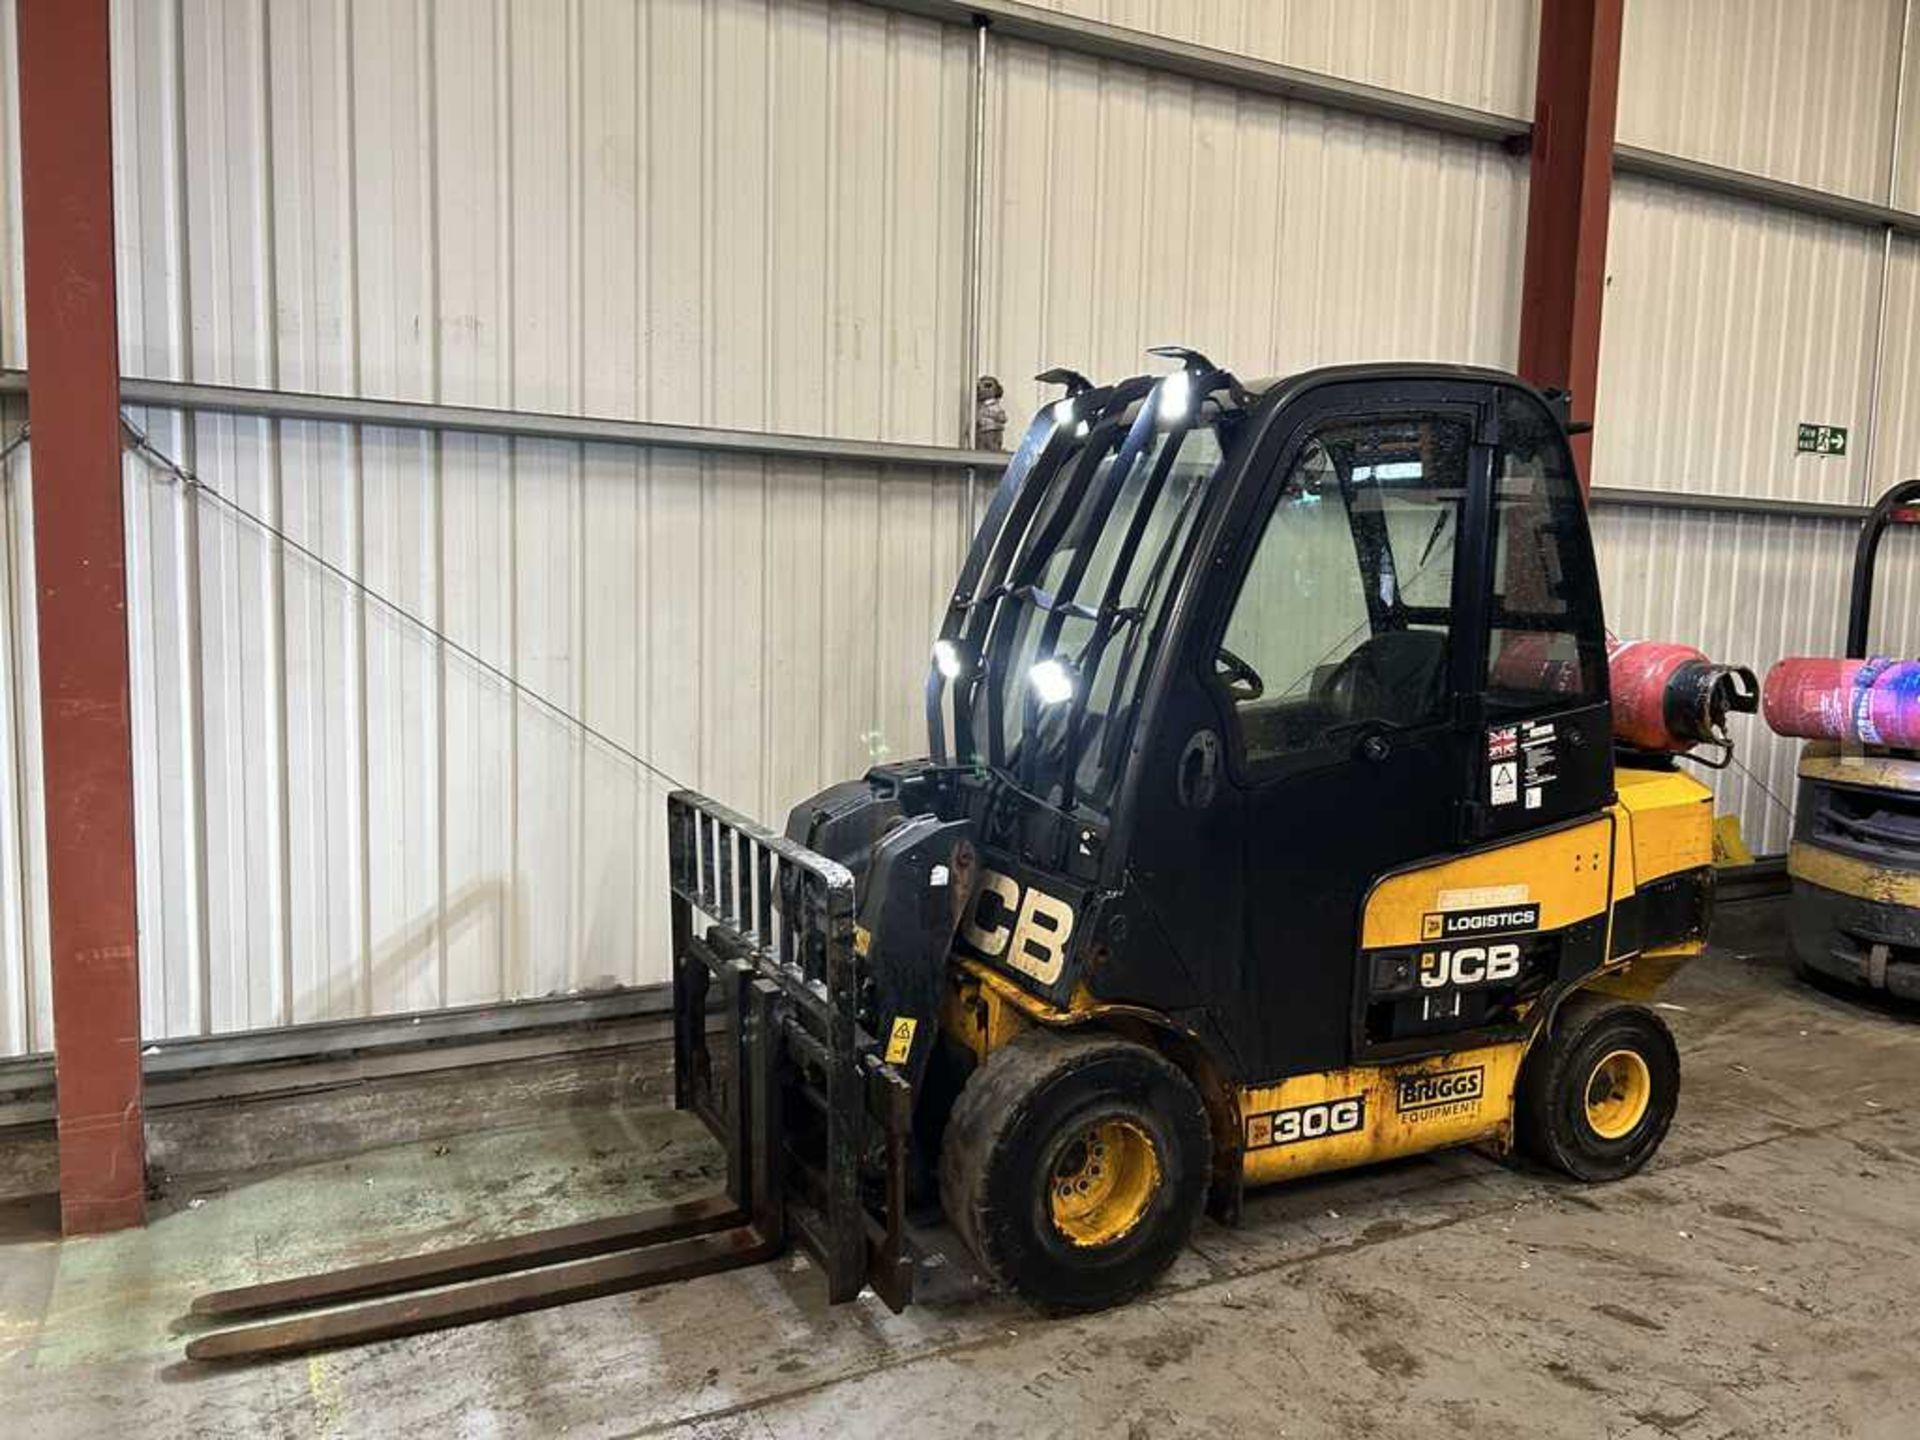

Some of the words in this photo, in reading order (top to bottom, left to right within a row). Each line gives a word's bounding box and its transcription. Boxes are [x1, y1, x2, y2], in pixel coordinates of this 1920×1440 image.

[961, 868, 1074, 986] CB
[1447, 910, 1535, 931] LOGISTICS
[1420, 944, 1520, 988] JCB
[1401, 1073, 1478, 1106] BRIGGS
[1273, 1101, 1360, 1143] 30G
[1401, 1101, 1477, 1124] EQUIPMENT
